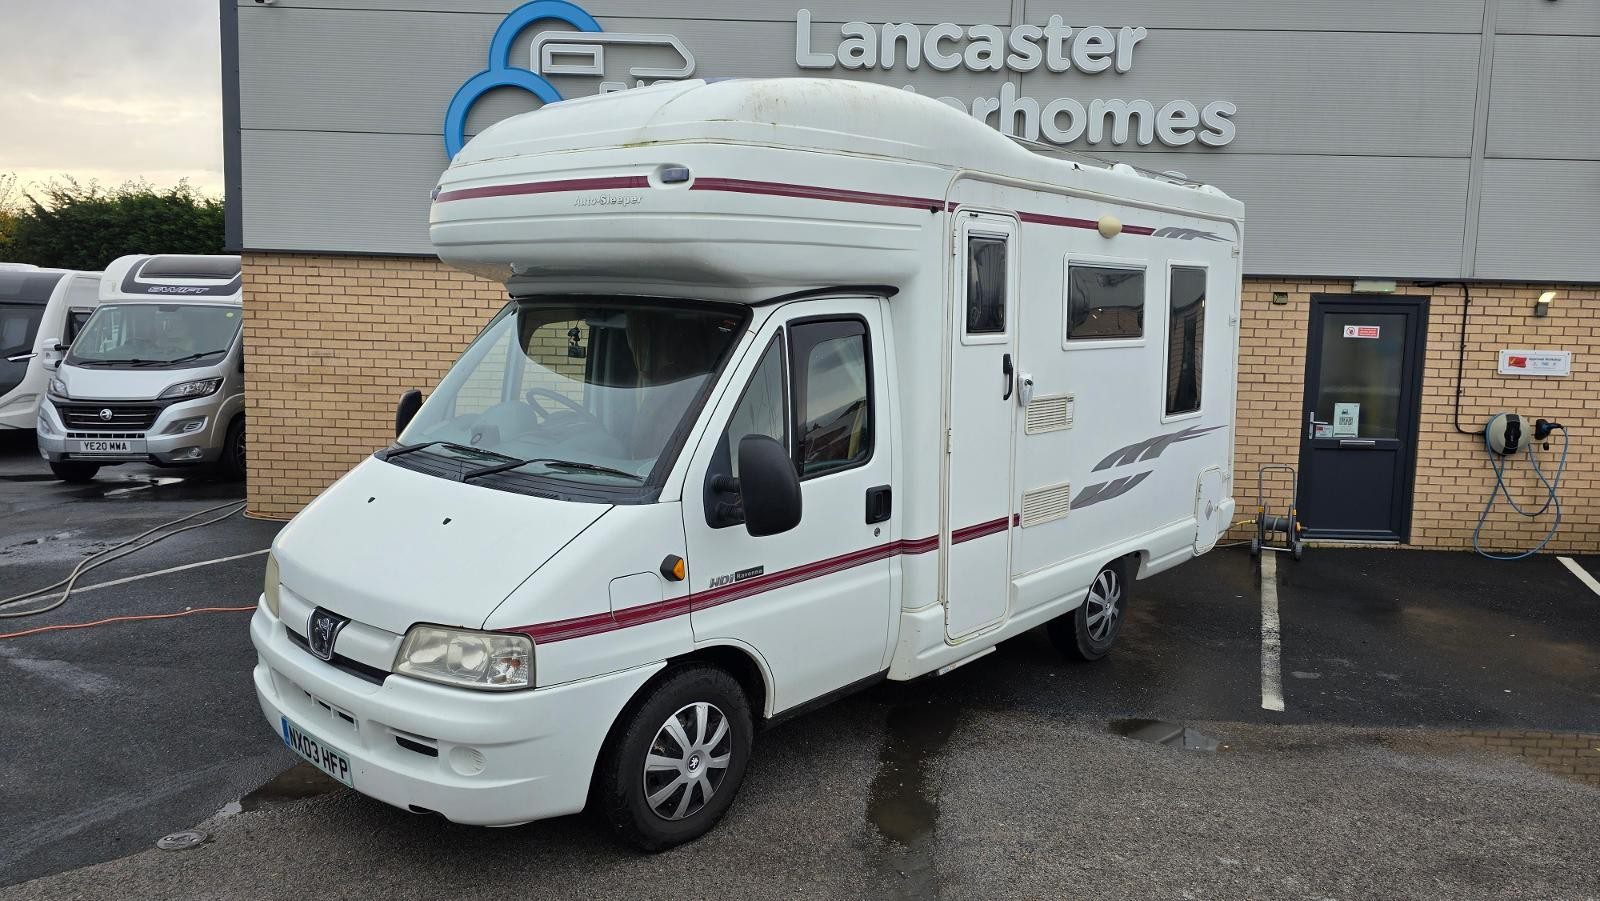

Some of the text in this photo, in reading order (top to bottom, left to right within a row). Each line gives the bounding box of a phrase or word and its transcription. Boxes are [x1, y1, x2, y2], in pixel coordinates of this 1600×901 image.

[795, 9, 1147, 74] Lancaster
[573, 193, 643, 207] Auto-Sleeper
[147, 286, 210, 294] SWIFT
[84, 441, 127, 451] YE20 MWA
[288, 725, 348, 779] NX03 HFP
